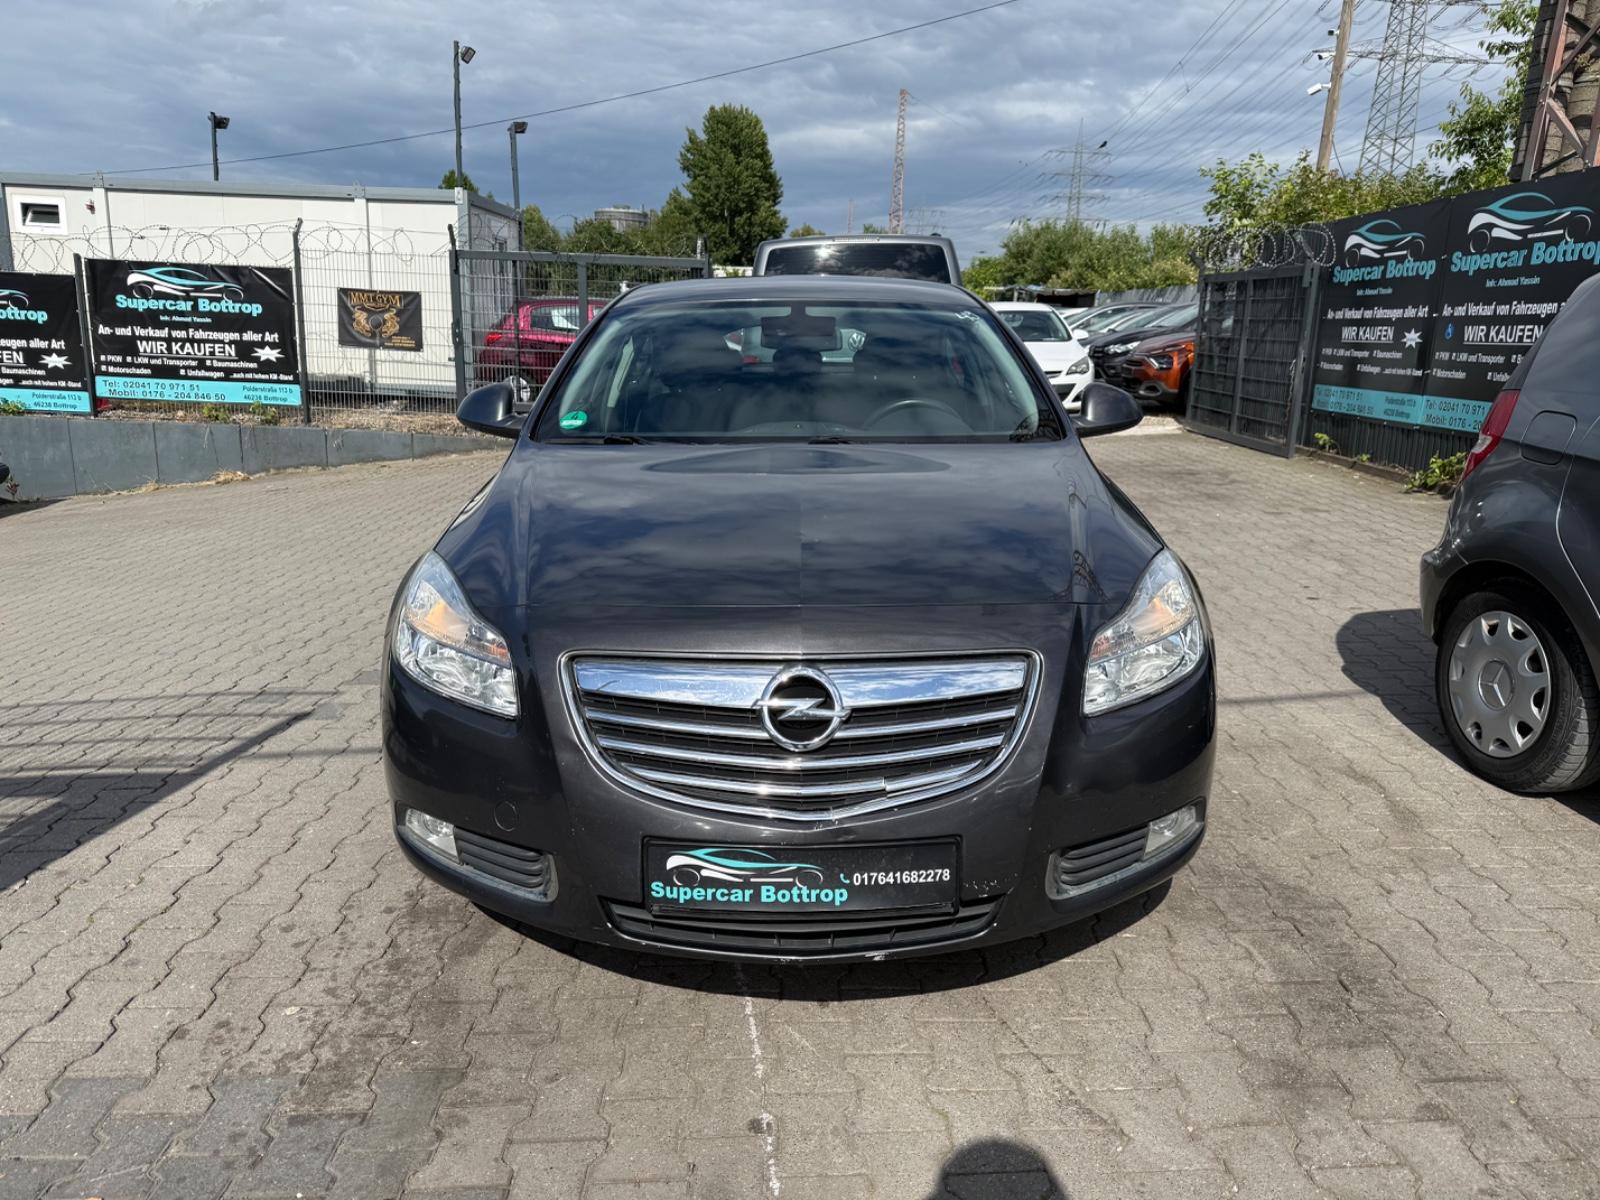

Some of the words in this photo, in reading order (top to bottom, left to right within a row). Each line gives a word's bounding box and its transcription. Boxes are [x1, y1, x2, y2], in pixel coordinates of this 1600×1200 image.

[1450, 249, 1527, 276] Supercar
[1332, 265, 1384, 286] Supercar
[1386, 258, 1436, 280] Bottrop
[115, 294, 194, 312] Supercar
[198, 298, 263, 317] Bottrop
[1344, 306, 1365, 319] Verkauf
[1373, 305, 1403, 321] Fahrzeugen
[1403, 304, 1418, 318] aller
[1417, 304, 1429, 318] Art
[1442, 303, 1453, 317] An-
[1453, 302, 1467, 316] und
[1468, 301, 1496, 316] Verkauf
[1496, 303, 1509, 316] von
[1510, 300, 1558, 318] Fahrzeugen
[0, 306, 48, 324] ottrop
[98, 324, 113, 335] An-
[115, 325, 132, 336] und
[133, 326, 168, 338] Verkauf
[171, 329, 187, 339] von
[188, 328, 240, 342] Fahrzeugen
[242, 330, 262, 341] aller
[264, 331, 279, 342] Art
[1341, 326, 1358, 341] WIR
[1358, 326, 1395, 341] KAUFEN
[1464, 325, 1486, 342] WIR
[1488, 324, 1544, 343] KAUFEN
[0, 338, 27, 349] eugen
[29, 337, 49, 348] aller
[51, 338, 65, 349] Art
[136, 340, 168, 354] WIR
[171, 341, 236, 357] KAUFEN
[0, 350, 24, 364] EN
[162, 358, 198, 367] Transporter
[213, 360, 258, 369] Baumaschinen
[1, 366, 46, 376] Baumaschinen
[103, 380, 120, 388] Tel:
[122, 381, 151, 389] 02041
[155, 382, 166, 390] 70
[142, 390, 165, 398] 0176
[194, 392, 211, 400] 846
[214, 393, 226, 401] 50
[1439, 400, 1460, 413] 02041
[1461, 402, 1471, 414] 70
[1471, 403, 1485, 416] 971
[1448, 416, 1466, 428] 0176
[1472, 419, 1481, 430] 20
[853, 868, 951, 886] 017641682278
[651, 881, 754, 903] Supercar
[760, 885, 848, 906] Bottrop
